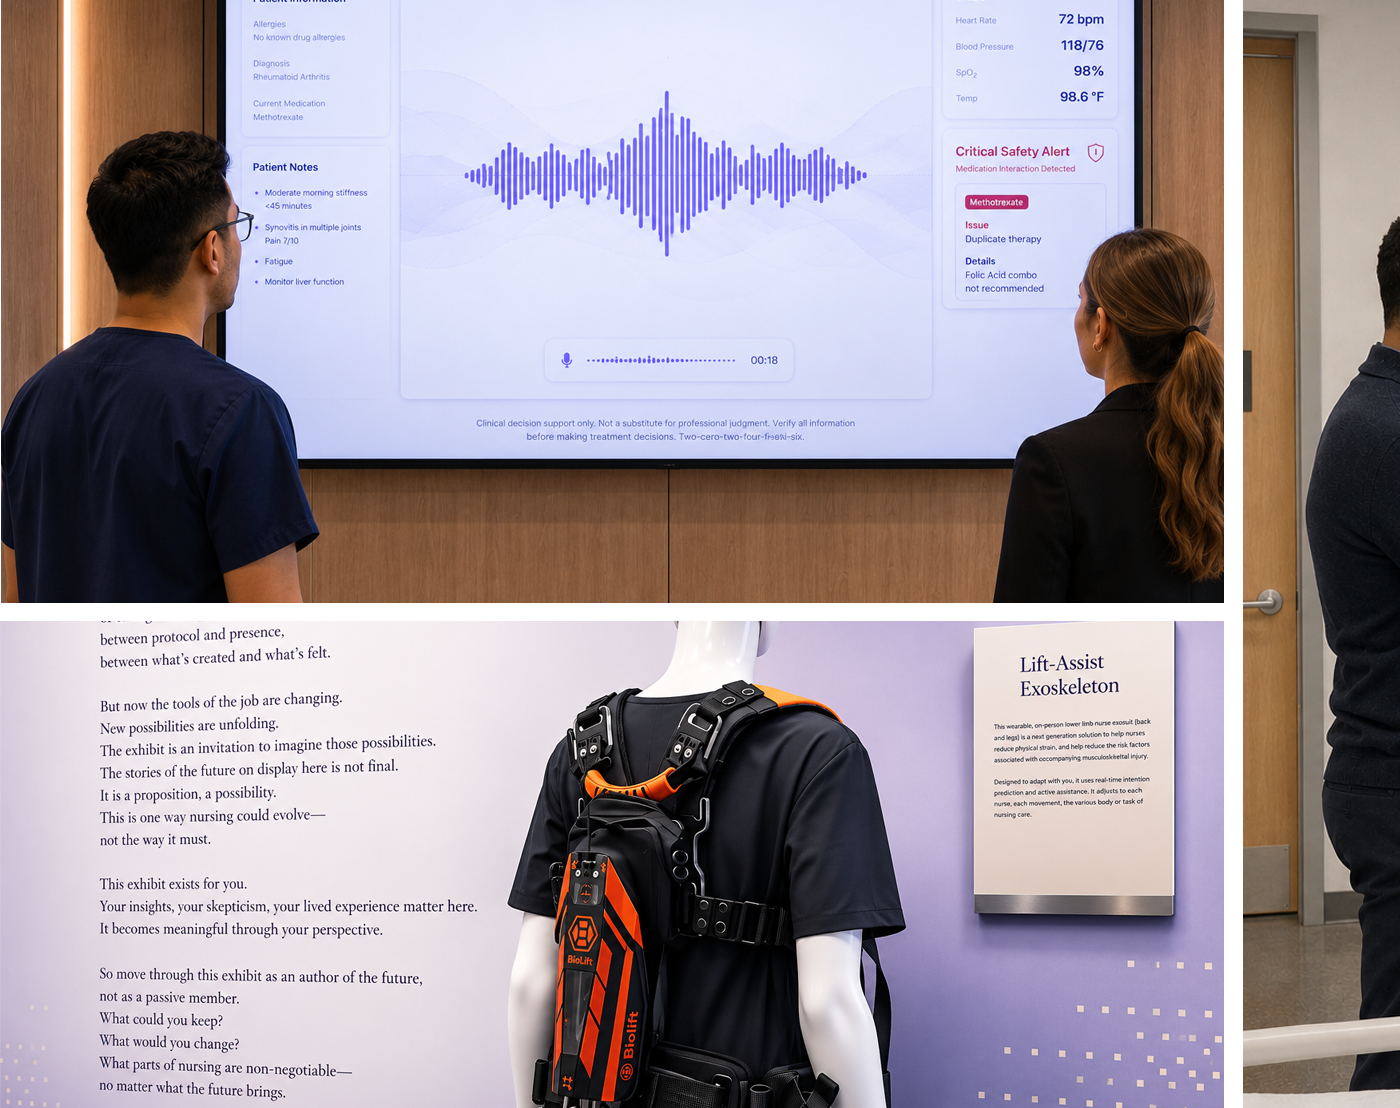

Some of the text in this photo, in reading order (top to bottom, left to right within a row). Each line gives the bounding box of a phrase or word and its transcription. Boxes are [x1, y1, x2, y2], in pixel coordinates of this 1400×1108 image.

[253, 20, 286, 29] Allergies
[1059, 14, 1104, 27] 72 bpm
[1061, 40, 1104, 52] 118/76
[253, 60, 290, 69] Diagnosis
[1074, 65, 1104, 76] 98%
[253, 73, 330, 81] Rheumatoid Arthritis
[956, 94, 978, 103] Temp
[1060, 91, 1088, 102] 98.6
[253, 99, 282, 107] Current
[253, 113, 304, 121] Methotrexate
[956, 146, 1070, 159] Critical Safety Alert
[253, 163, 318, 172] Patient Notes
[265, 189, 301, 197] Moderate
[303, 189, 334, 198] morning
[265, 202, 312, 210] <45 minutes
[970, 198, 1023, 207] Methotrexate
[265, 223, 299, 233] Synovitis
[309, 224, 339, 232] multiple
[340, 224, 361, 232] joints
[965, 221, 989, 229] Issue
[283, 237, 299, 245] 7/10
[965, 235, 1042, 245] Duplicate therapy
[265, 257, 293, 267] Fatigue
[965, 257, 996, 265] Details
[965, 270, 1037, 279] Folic Acid combo
[982, 284, 1044, 292] recommended
[751, 356, 778, 365] 00:18
[100, 627, 284, 647] between protocol and presence,
[1021, 654, 1104, 672] Lift-Assist
[1021, 678, 1119, 696] Exoskeleton
[100, 716, 278, 737] New possibilities are unfolding.
[100, 734, 436, 757] The exhibit is an invitation to imagine those possibilities.
[99, 877, 247, 893] This exhibit exists for you.
[100, 899, 477, 916] Your insights, your skepticism, your lived experience matter here.
[100, 922, 383, 939] It becomes meaningful through your perspective.
[567, 954, 593, 966] BioLift
[623, 1011, 639, 1060] Biolift
[99, 1056, 130, 1069] What
[133, 1061, 160, 1073] parts
[163, 1058, 177, 1071] of
[178, 1060, 221, 1076] nursing
[225, 1064, 243, 1074] are
